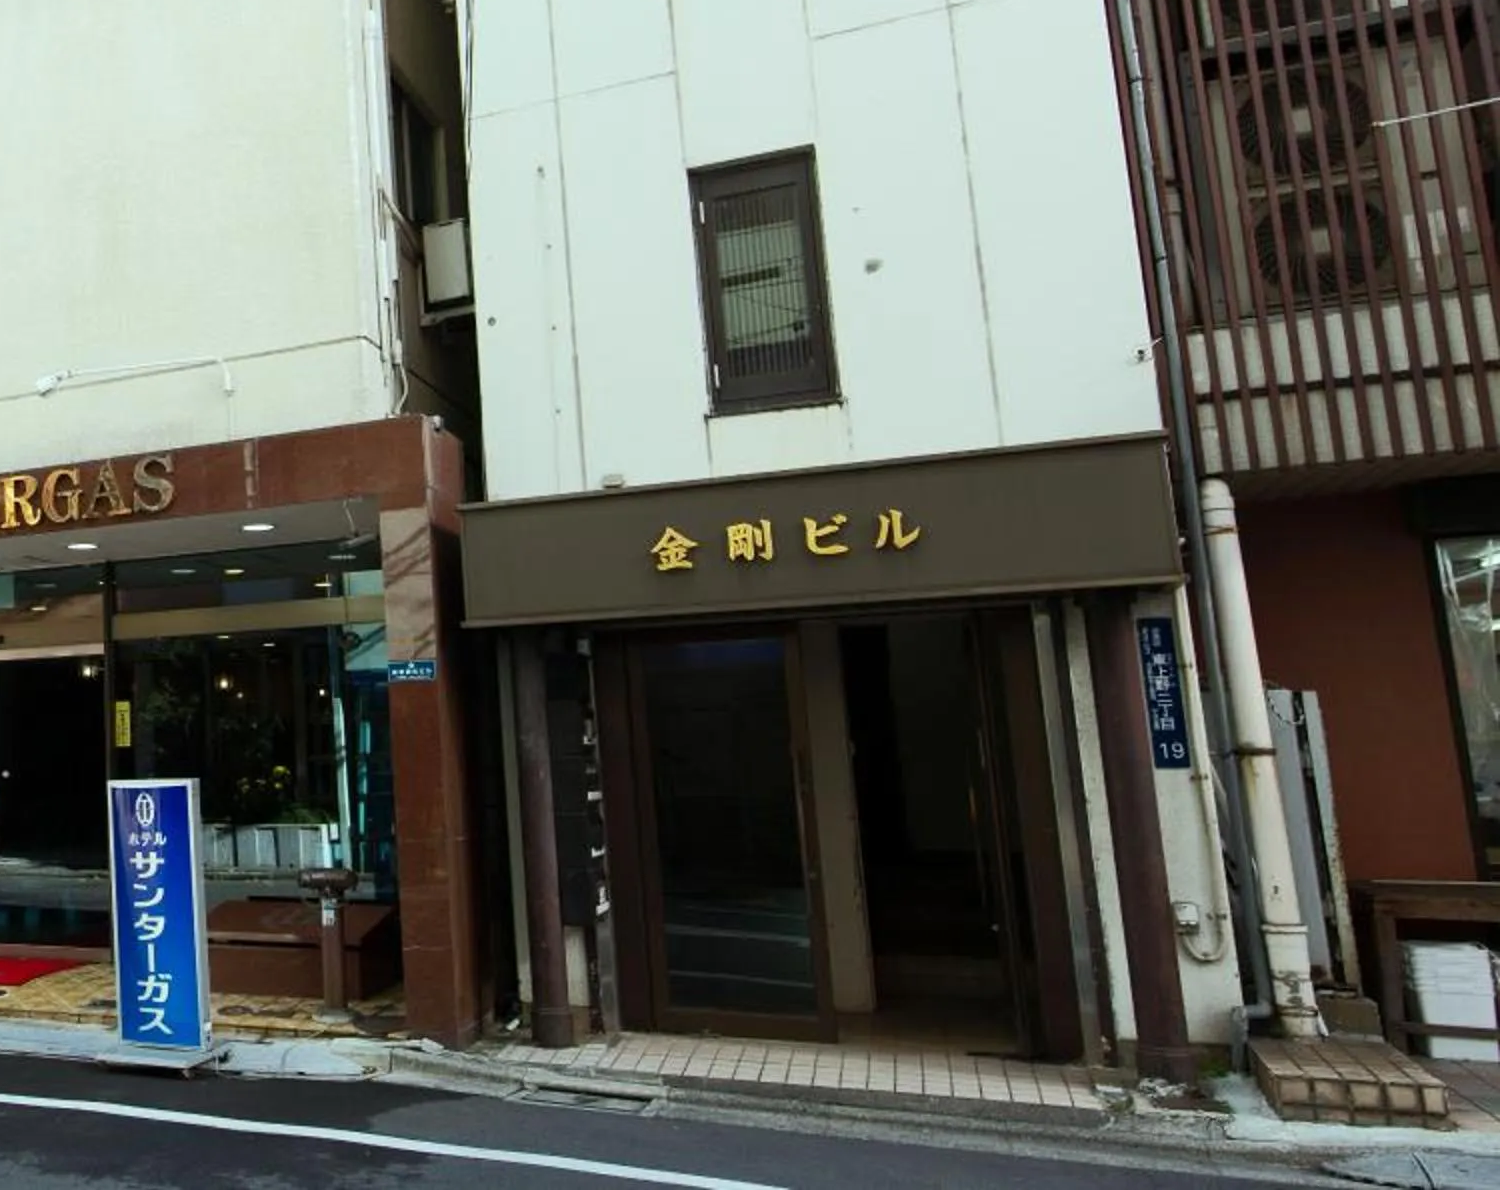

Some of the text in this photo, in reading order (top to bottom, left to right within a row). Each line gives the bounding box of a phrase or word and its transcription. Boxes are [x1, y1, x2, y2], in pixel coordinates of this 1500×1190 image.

[650, 508, 921, 572] 金剛ビル
[1159, 741, 1186, 759] 19
[128, 831, 167, 846] ホテル
[129, 851, 174, 1036] サンターガス
